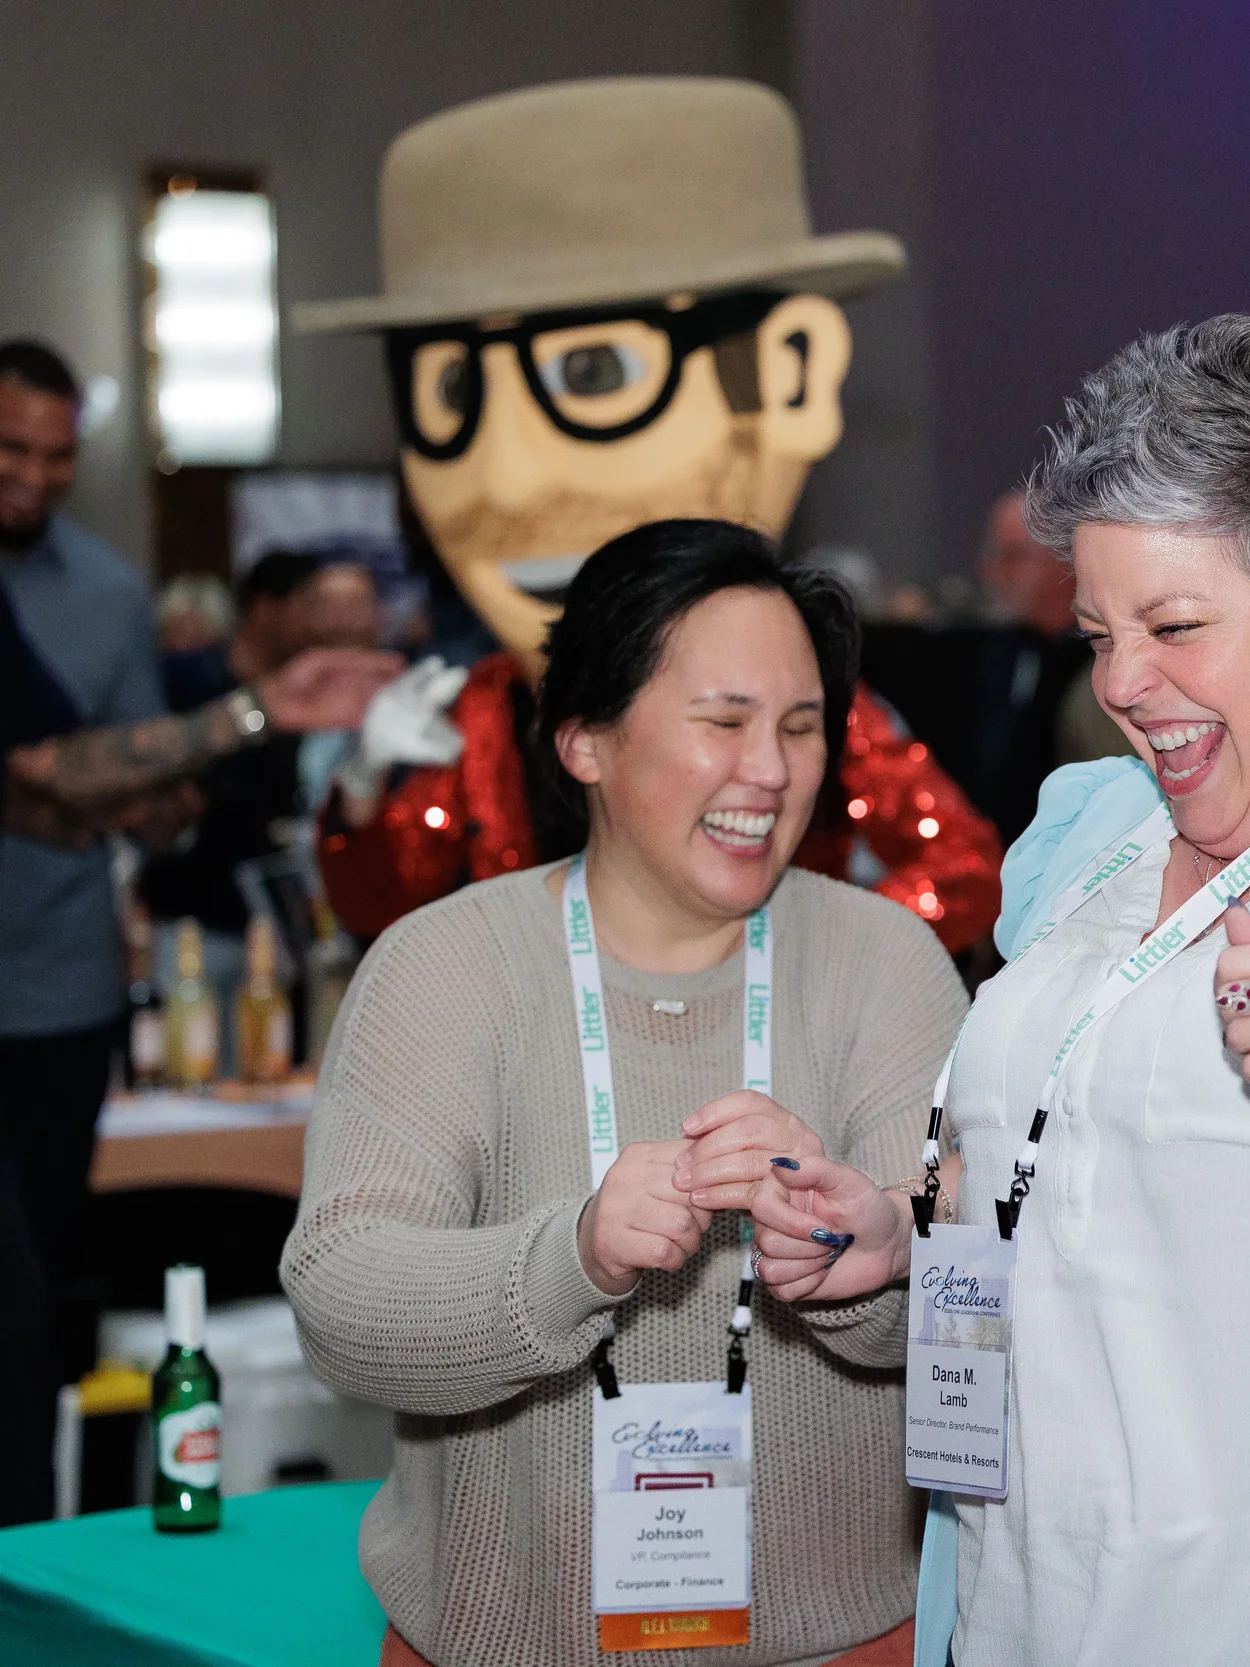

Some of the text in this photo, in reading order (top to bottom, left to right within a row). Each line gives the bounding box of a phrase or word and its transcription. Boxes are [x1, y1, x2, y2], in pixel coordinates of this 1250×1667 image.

[1081, 841, 1144, 898] Littler
[1118, 918, 1187, 984] Littler
[582, 985, 605, 1052] Littler
[593, 1083, 614, 1154] Littler
[921, 1265, 979, 1290] Evolving
[934, 1286, 1001, 1312] Excellence
[932, 1364, 977, 1385] Dana M.
[940, 1391, 968, 1408] Lamb
[909, 1415, 926, 1426] Senior
[949, 1420, 965, 1431] Brand
[966, 1422, 999, 1436] Performance
[907, 1446, 1000, 1469] Crescent Hotels & Resorts
[655, 1507, 686, 1524] Joy
[636, 1527, 704, 1542] Johnson
[649, 1550, 711, 1563] Compliance
[615, 1579, 671, 1591] Corporate
[680, 1576, 725, 1588] Finance
